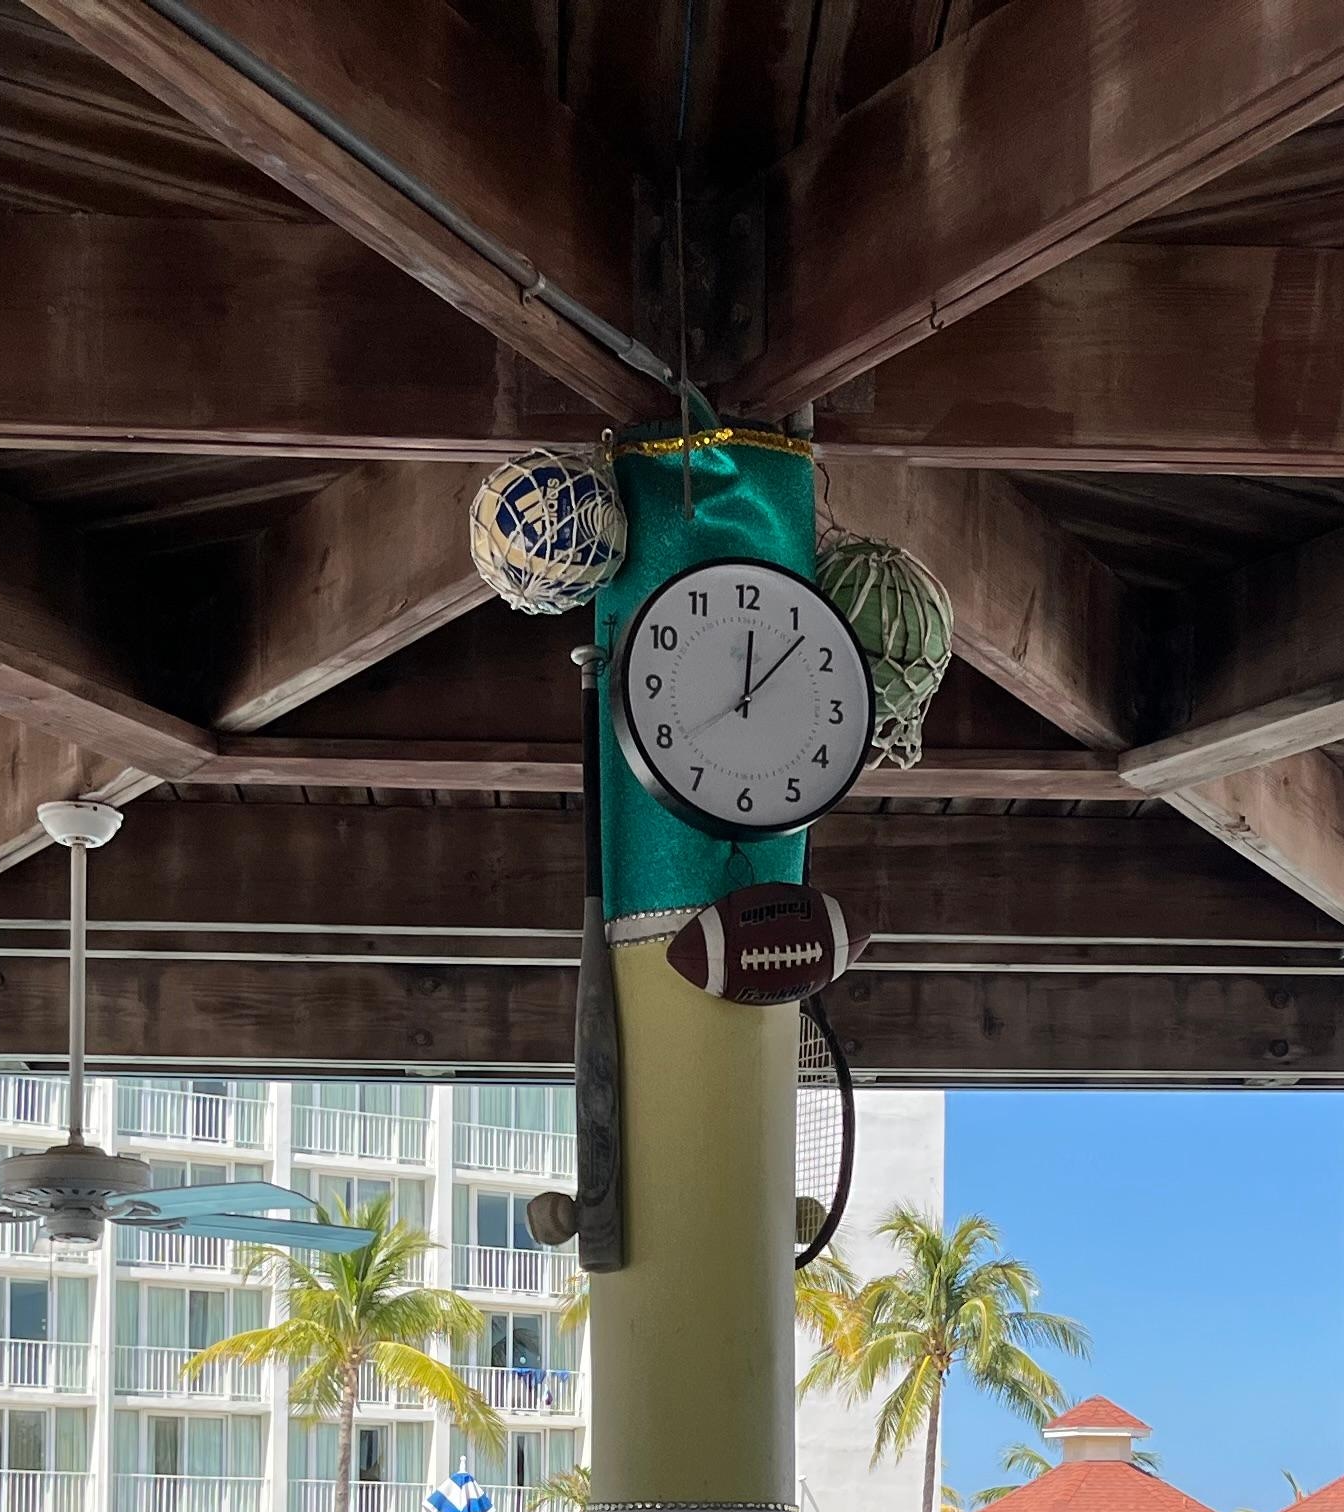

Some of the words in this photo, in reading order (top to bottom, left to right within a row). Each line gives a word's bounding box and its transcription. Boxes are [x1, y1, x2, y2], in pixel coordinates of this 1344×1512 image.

[688, 591, 708, 617] 11
[735, 584, 760, 611] 12
[789, 606, 799, 631] 1
[650, 624, 678, 651] 10
[819, 647, 834, 672] 2
[645, 674, 663, 699] 9
[828, 700, 844, 725] 3
[656, 724, 673, 749] 8
[811, 744, 829, 769] 4
[689, 766, 704, 791] 7
[785, 778, 801, 803] 5
[736, 788, 754, 813] 6
